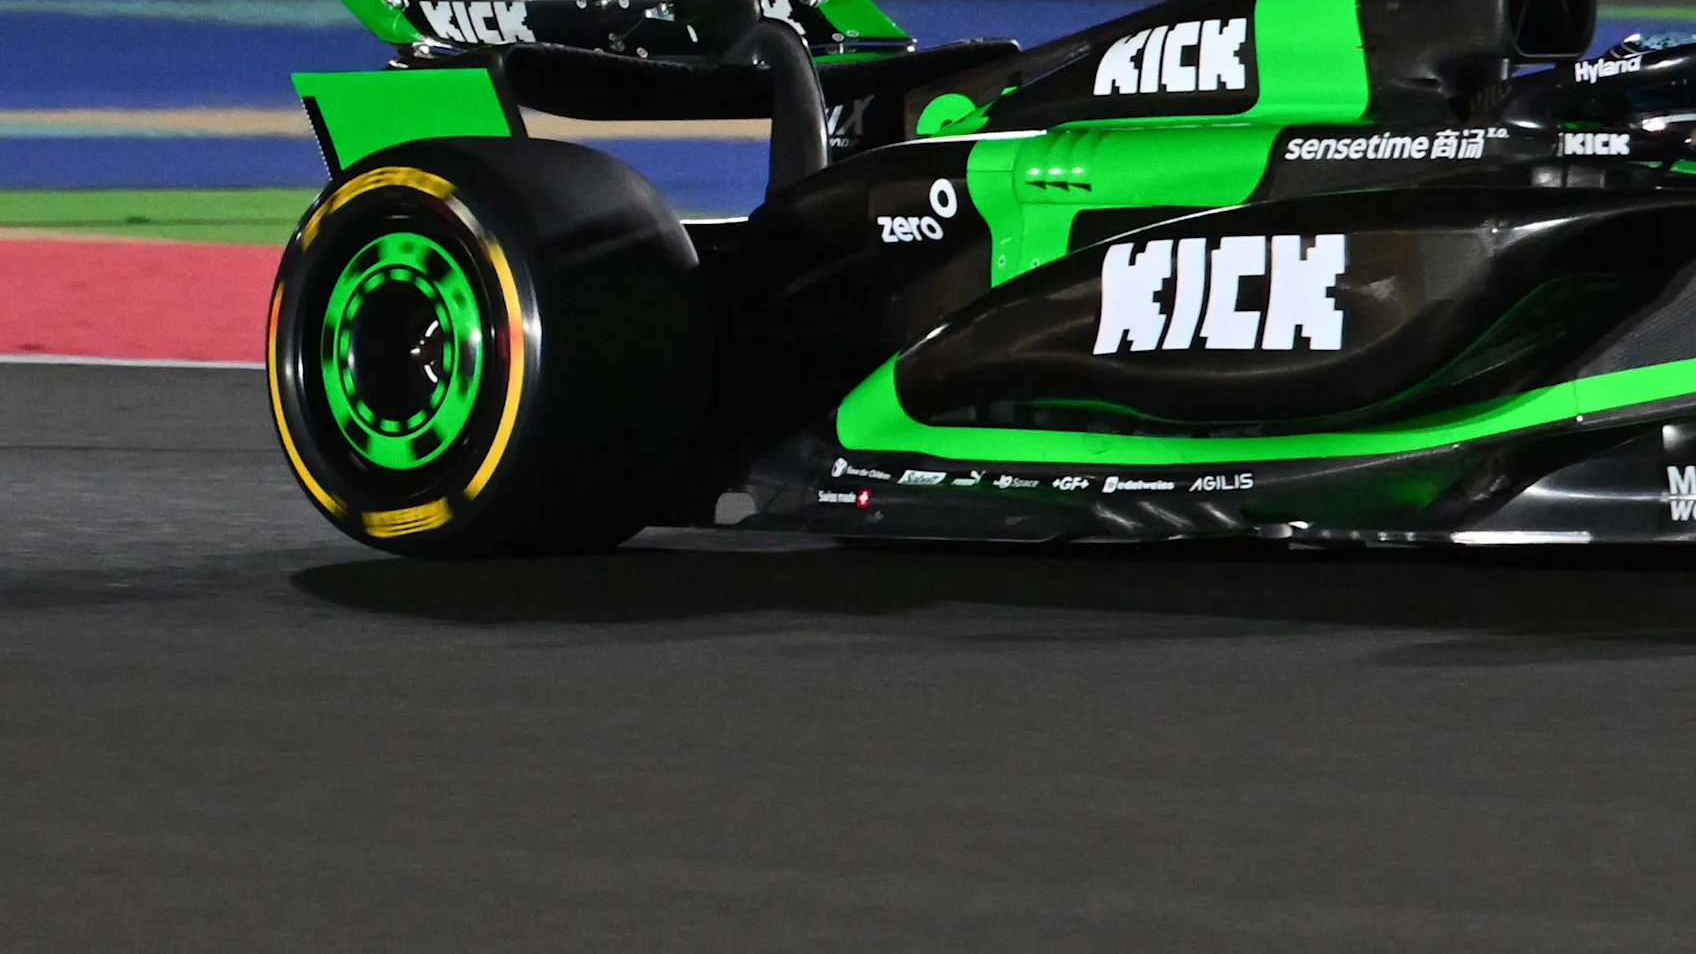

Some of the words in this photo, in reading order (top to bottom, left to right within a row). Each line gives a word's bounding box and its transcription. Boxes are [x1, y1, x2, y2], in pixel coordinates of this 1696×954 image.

[418, 0, 536, 44] KICK
[1093, 17, 1247, 96] KICK
[1574, 55, 1642, 84] Hyland
[1284, 131, 1429, 161] sensetime
[1564, 132, 1630, 155] KICK
[1092, 233, 1346, 355] KICK
[1189, 473, 1254, 492] AGILIS
